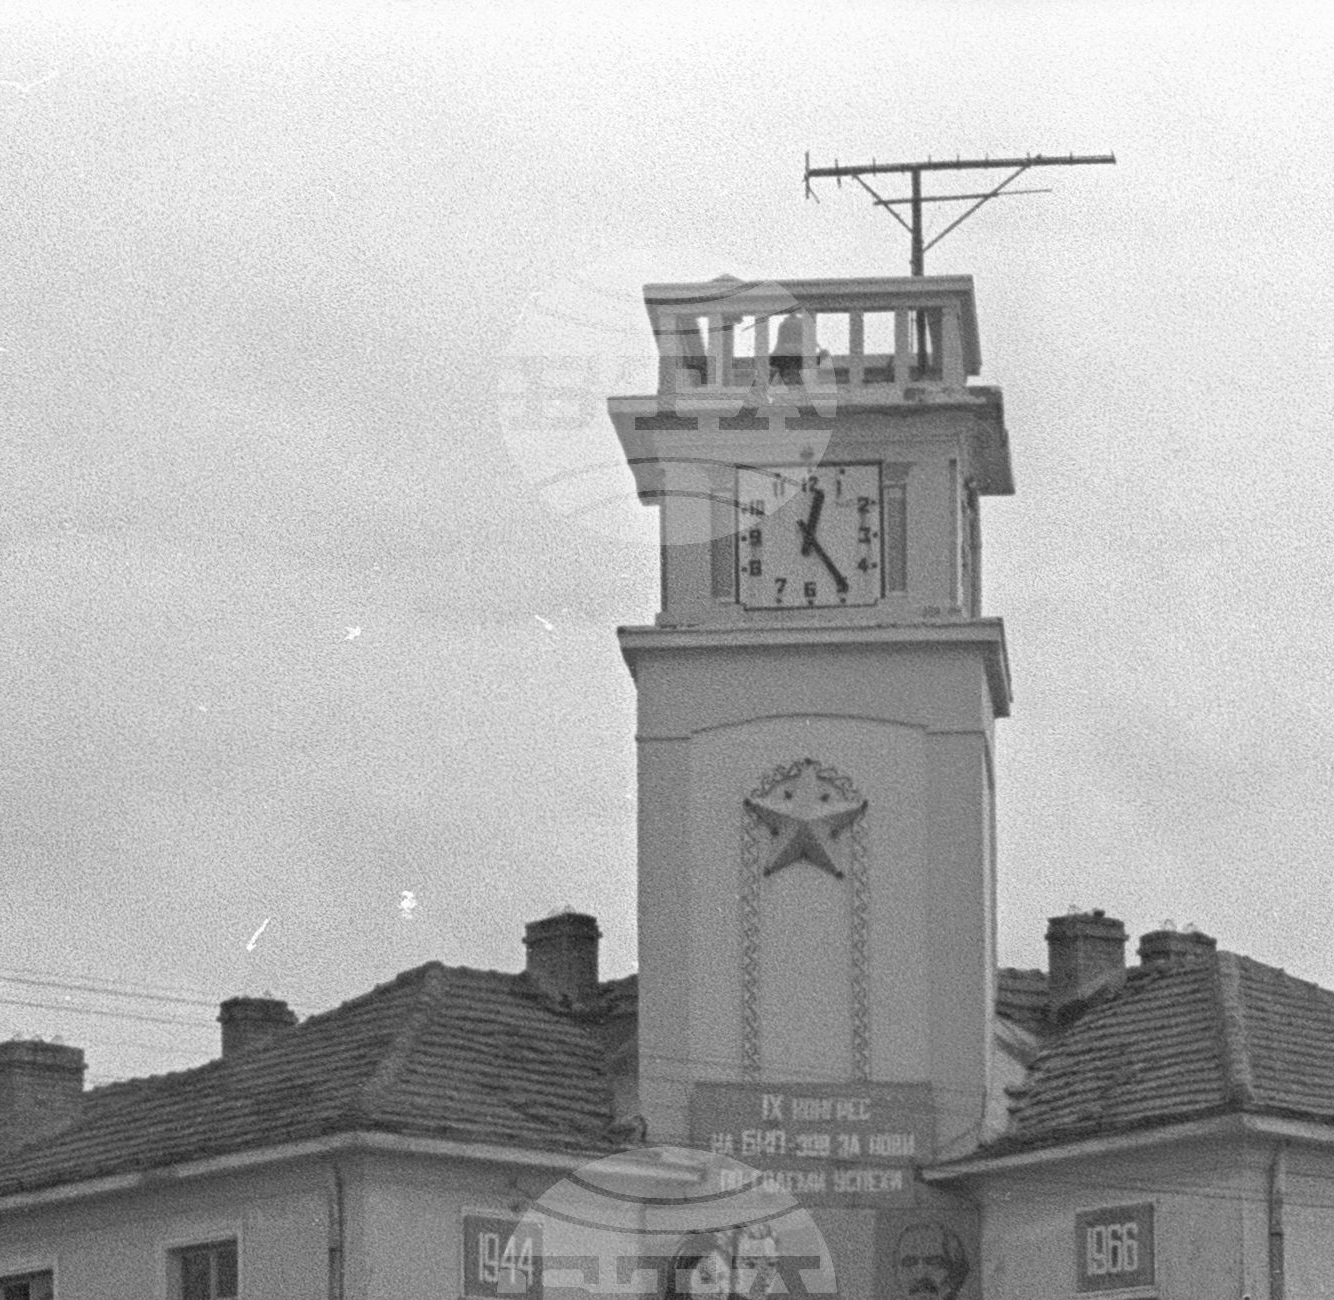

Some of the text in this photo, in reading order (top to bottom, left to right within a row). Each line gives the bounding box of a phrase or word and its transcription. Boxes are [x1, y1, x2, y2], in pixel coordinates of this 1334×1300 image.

[857, 496, 870, 514] 2
[749, 528, 763, 547] 9
[857, 526, 871, 545] 3
[749, 560, 763, 578] 8
[856, 556, 870, 574] 4
[773, 577, 788, 595] 7
[803, 581, 818, 598] 6
[762, 1093, 784, 1121] IX
[1087, 1222, 1139, 1276] 1966
[478, 1232, 534, 1285] 1944
